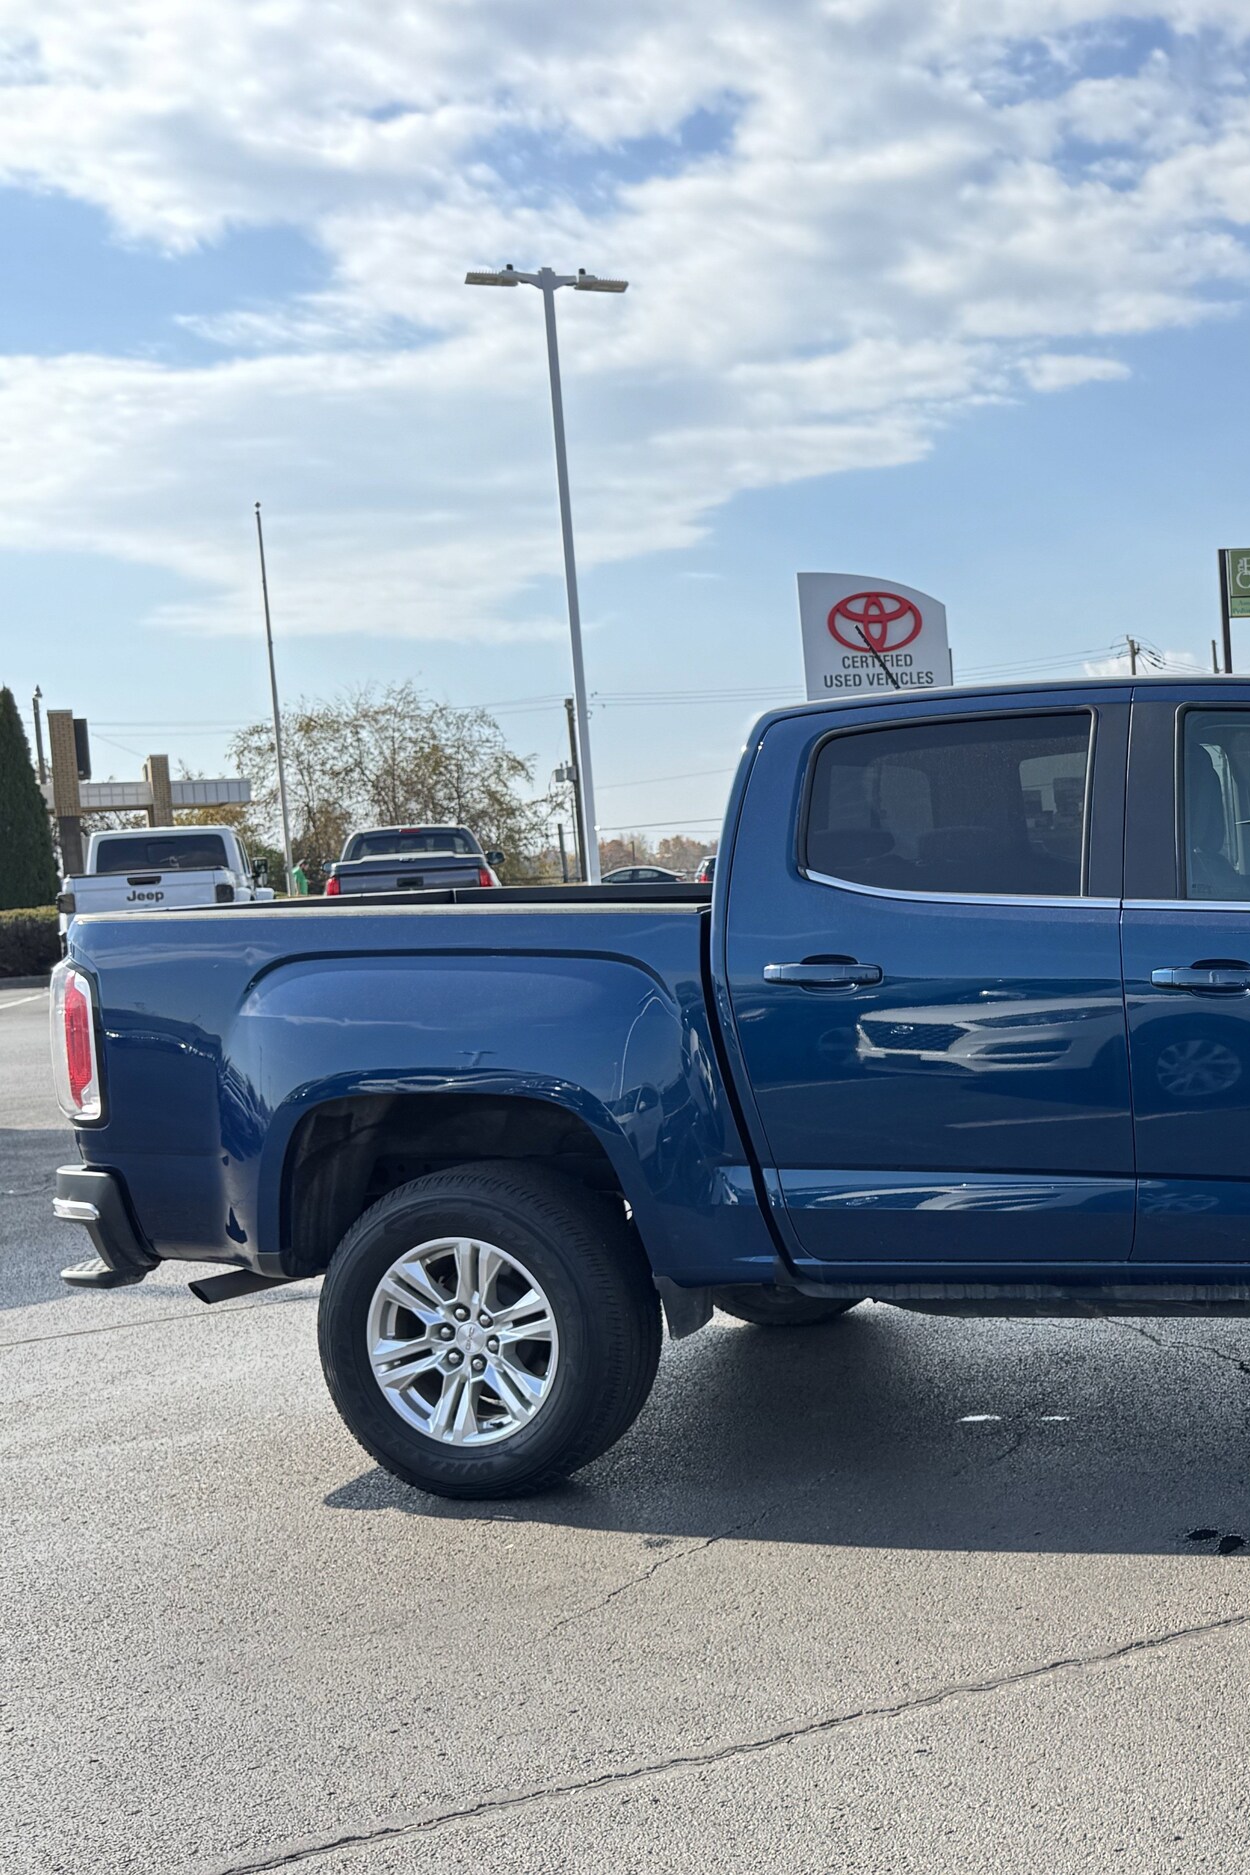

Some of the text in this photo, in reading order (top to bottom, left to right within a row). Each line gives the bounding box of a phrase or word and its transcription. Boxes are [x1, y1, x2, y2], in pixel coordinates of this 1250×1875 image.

[841, 653, 913, 669] CERTFIED
[824, 673, 862, 688] USED
[126, 890, 164, 903] Jeep
